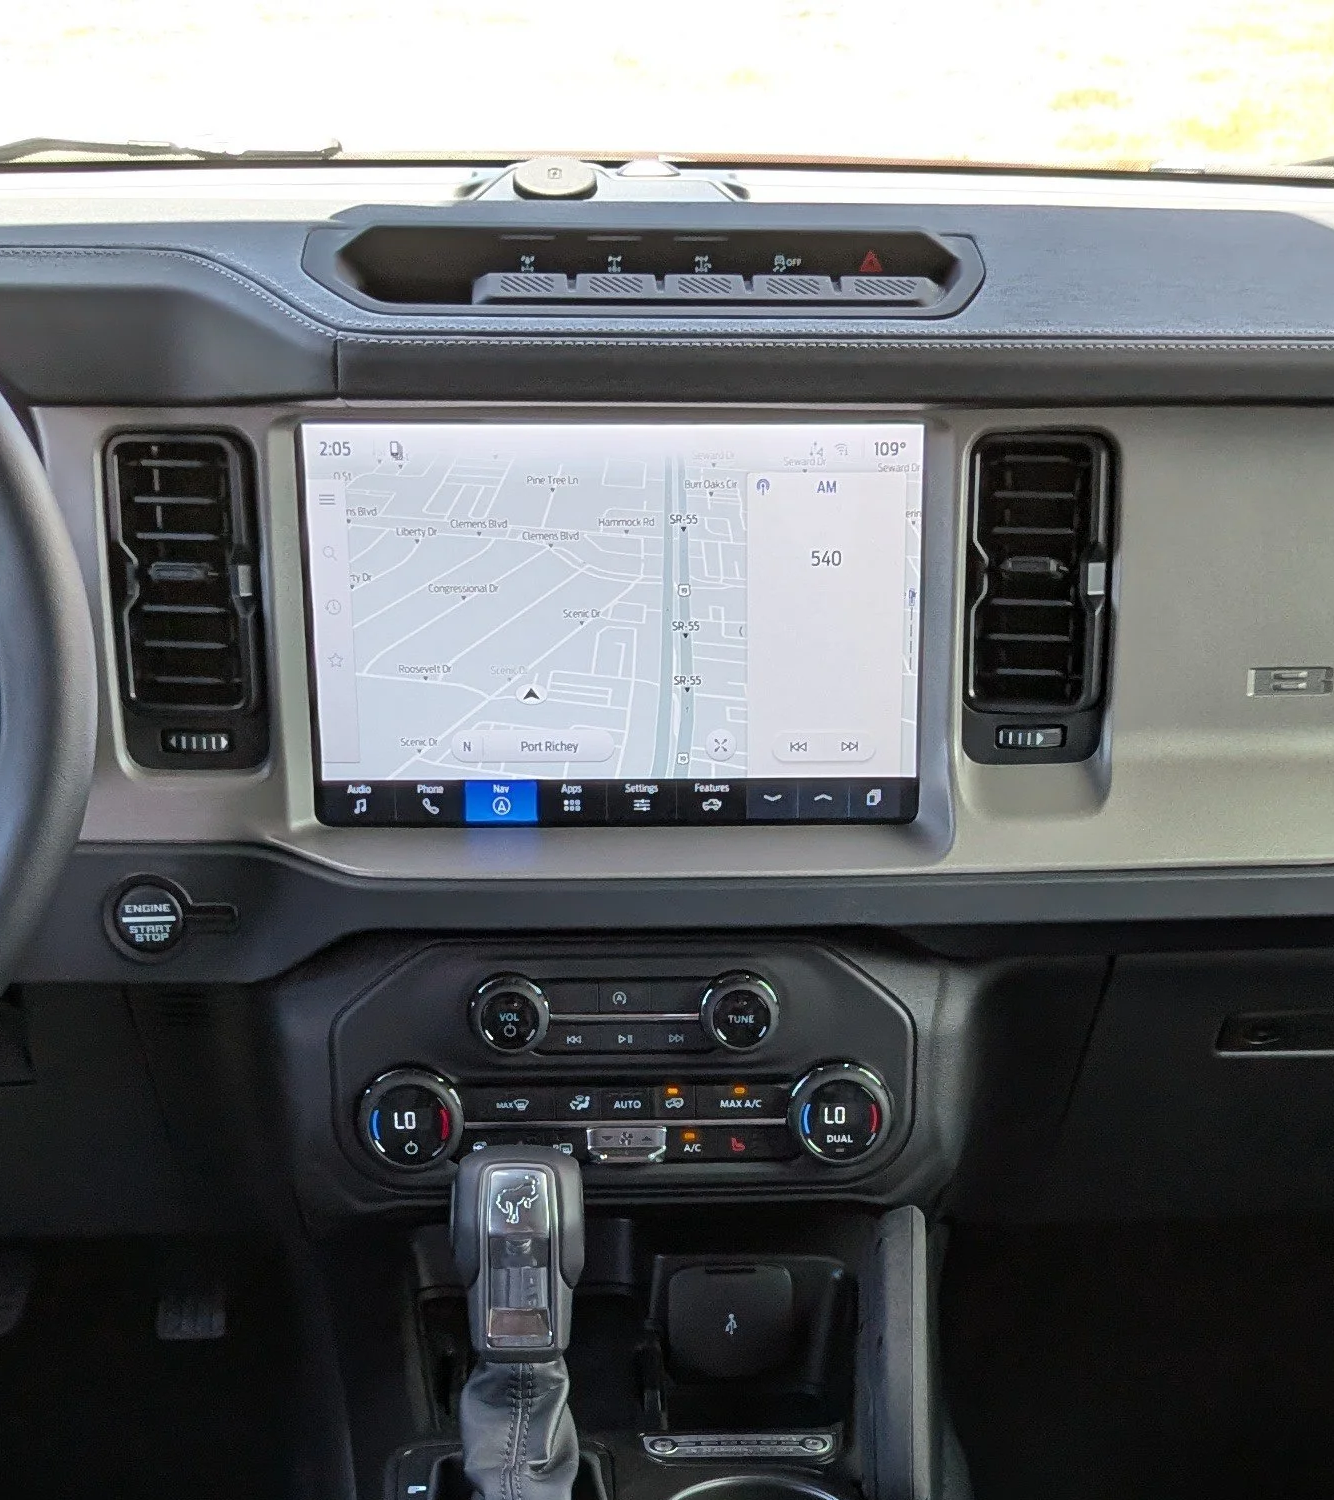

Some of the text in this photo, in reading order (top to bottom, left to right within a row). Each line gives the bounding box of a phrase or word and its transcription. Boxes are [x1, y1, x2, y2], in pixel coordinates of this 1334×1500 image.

[319, 441, 352, 457] 2:05
[874, 441, 907, 456] 109°
[783, 456, 816, 467] Seward
[877, 463, 909, 473] Seward
[526, 475, 579, 485] Pine Tree Ln
[684, 480, 738, 489] Burr Oaks Cir
[817, 480, 837, 494] AM
[357, 506, 378, 517] Blvd
[450, 519, 508, 529] Clemens Blvd
[598, 518, 655, 527] Hammock Rd
[669, 514, 698, 525] SR-55
[396, 527, 437, 538] Liberty Dr
[522, 531, 580, 541] Clemens Blvd
[811, 550, 842, 567] 540
[362, 573, 372, 582] Dr
[428, 583, 499, 595] Congressional Dr
[562, 609, 601, 619] Scenic Dr
[672, 621, 700, 632] SR-55
[398, 664, 452, 674] Roosevelt Dr
[673, 675, 702, 686] SR-55
[400, 737, 438, 747] Scenic Dr
[463, 742, 472, 752] N
[520, 740, 579, 754] Port Richey
[347, 784, 372, 794] Audio
[417, 784, 444, 794] Phone
[493, 784, 510, 794] Nav
[560, 784, 583, 795] Apps
[624, 783, 659, 794] Settings
[694, 783, 730, 793] Features
[124, 903, 171, 914] ENGINE
[129, 924, 172, 934] START
[135, 932, 169, 942] STOP
[499, 1012, 520, 1022] VOL
[727, 1014, 755, 1024] TUNE
[496, 1101, 514, 1109] MAX
[613, 1099, 642, 1109] AUTO
[720, 1099, 762, 1109] MAX A/C
[393, 1111, 416, 1130] LO
[824, 1107, 846, 1125] LO
[826, 1134, 854, 1144] DUAL
[683, 1143, 702, 1153] A/C
